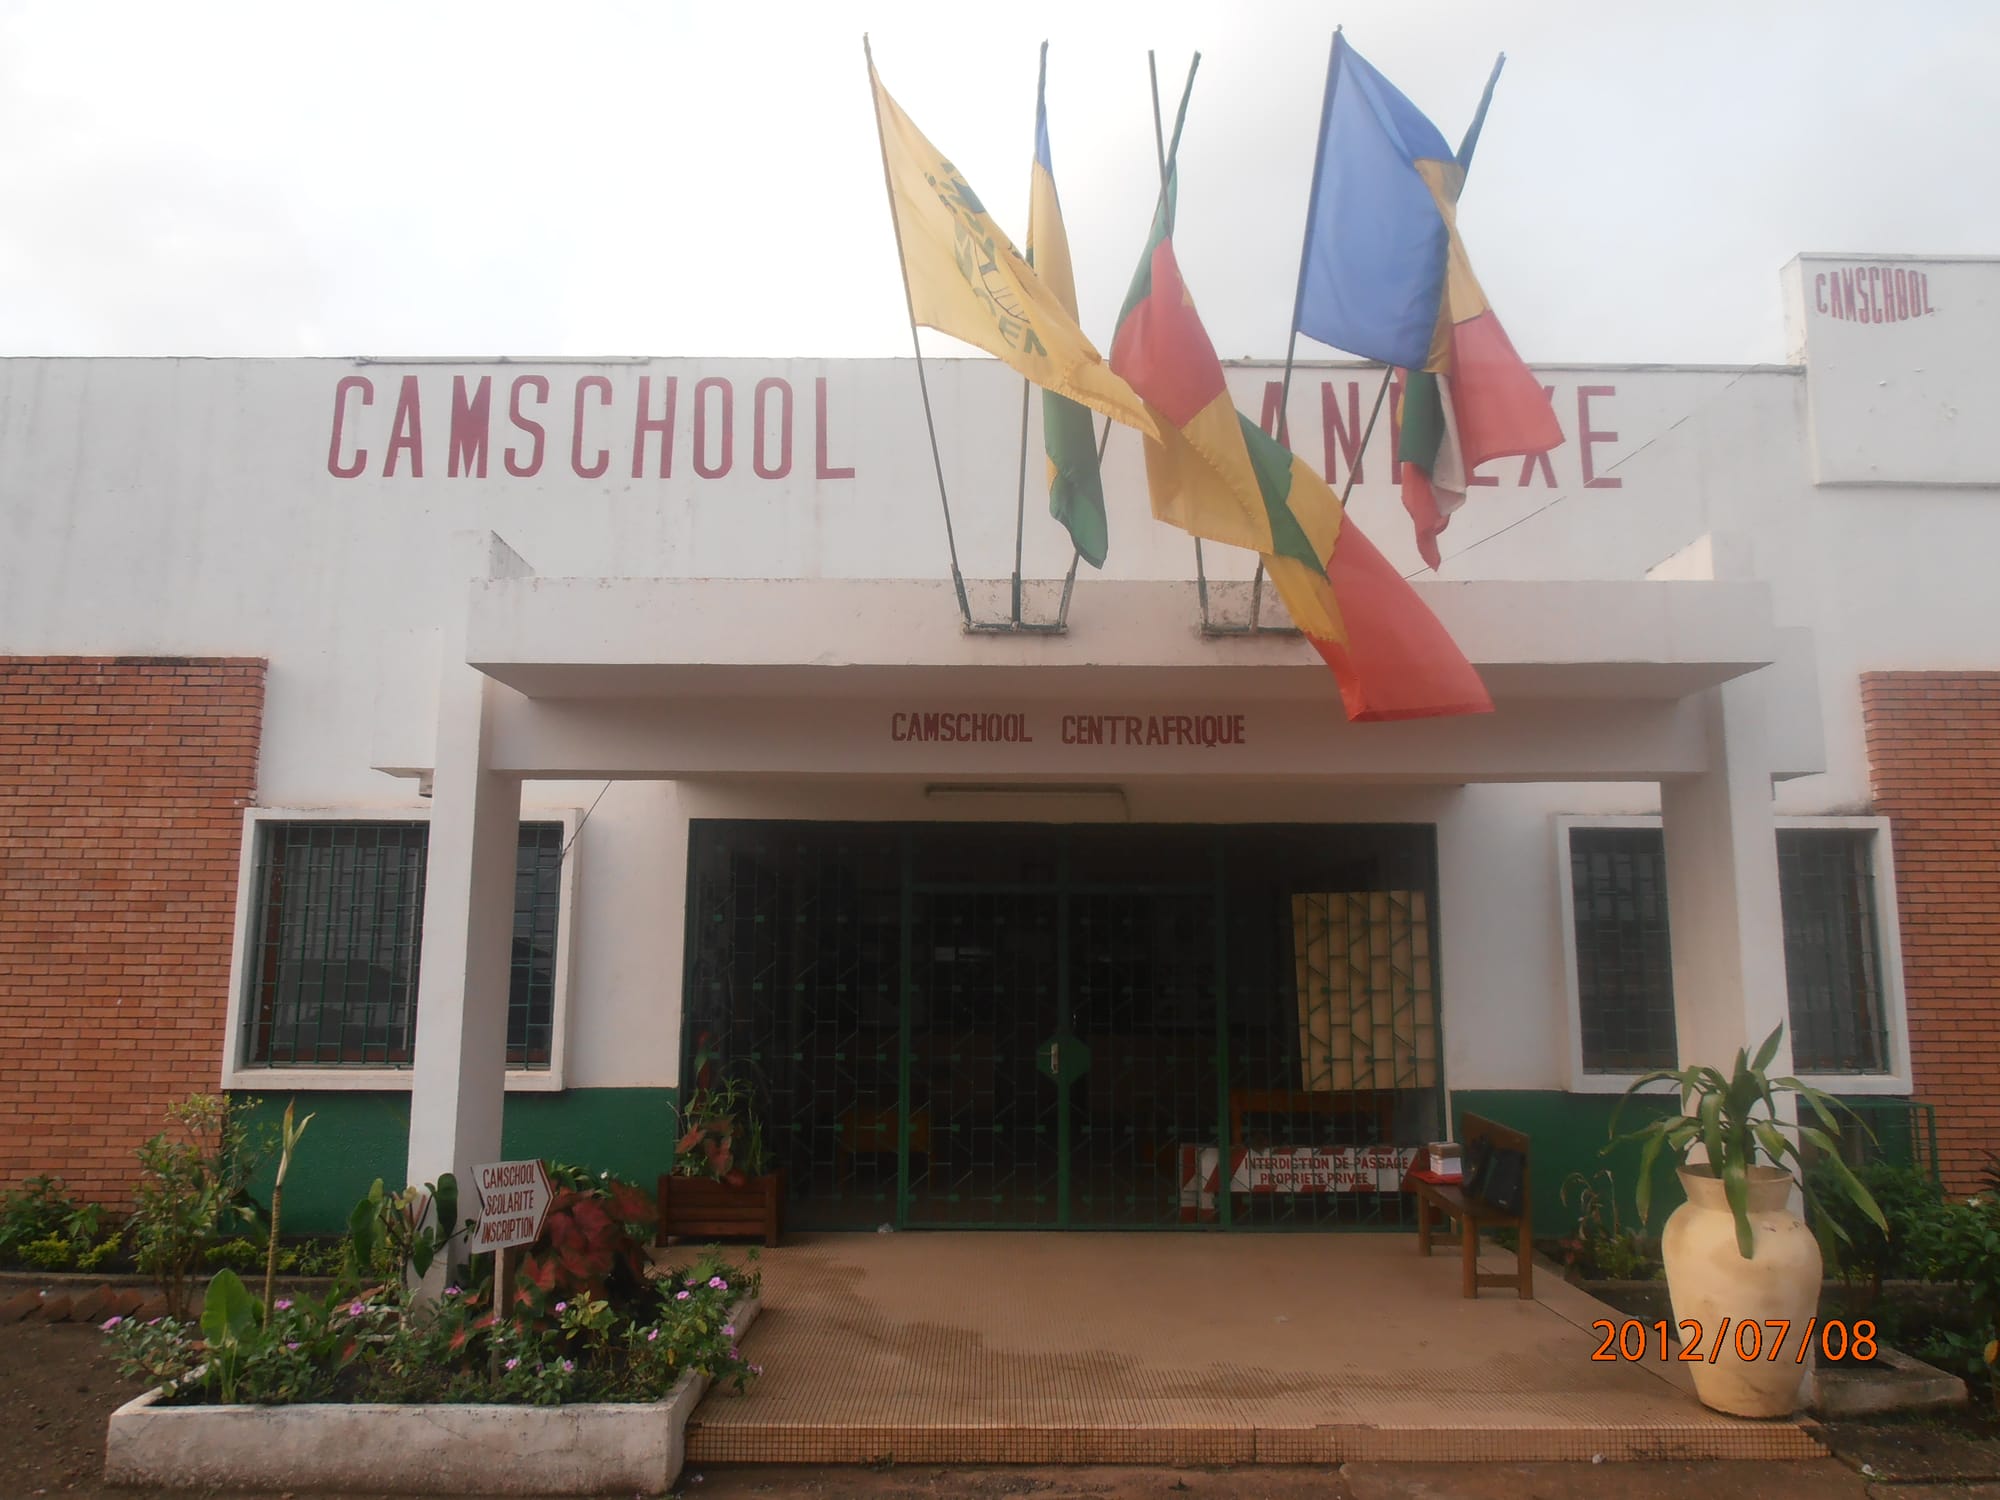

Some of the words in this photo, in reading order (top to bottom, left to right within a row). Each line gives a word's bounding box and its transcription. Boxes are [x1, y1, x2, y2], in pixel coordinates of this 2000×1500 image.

[1815, 266, 1934, 323] CAMSCHOOL
[327, 375, 856, 480] CAMSCHOOL
[891, 712, 1033, 743] CAMSCHOOL
[1061, 714, 1246, 748] CENTRAFRIQUE
[482, 1164, 536, 1190] CAMSCHOOL
[484, 1189, 535, 1217] SCOLARITE
[480, 1215, 535, 1245] INSCRIPTION
